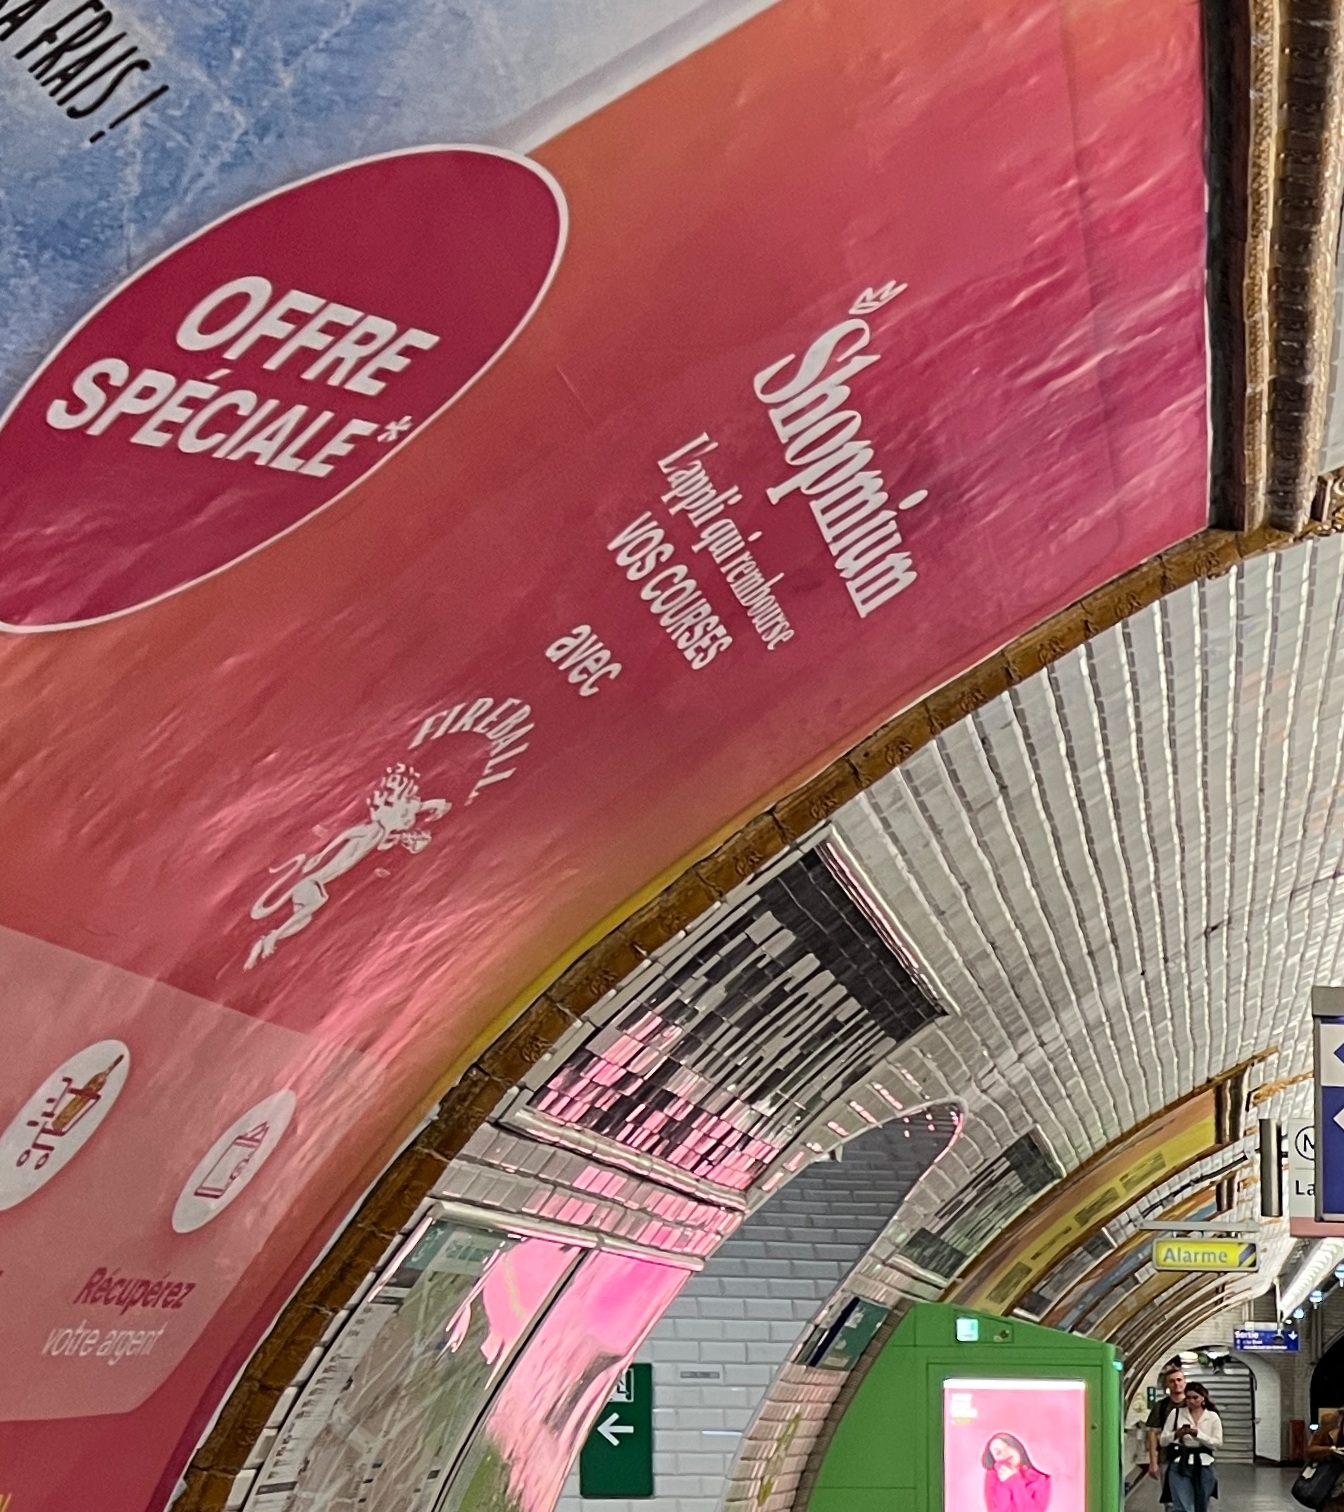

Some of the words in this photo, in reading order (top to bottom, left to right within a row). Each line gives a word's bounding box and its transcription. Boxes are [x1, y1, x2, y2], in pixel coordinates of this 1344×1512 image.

[14, 0, 151, 119] FRAIS
[176, 276, 440, 396] OFFRE
[657, 431, 743, 528] L'appli
[754, 318, 928, 618] Shopmium
[607, 511, 675, 581] VOS
[691, 518, 763, 564] qui
[640, 564, 733, 671] COURSES
[720, 550, 795, 650] rembourse
[545, 624, 622, 697] avec
[407, 697, 535, 806] FIREBALL
[72, 1265, 197, 1317] Récupérez
[1162, 1247, 1229, 1264] Alarme
[41, 1319, 101, 1357] votre
[96, 1321, 168, 1367] argent
